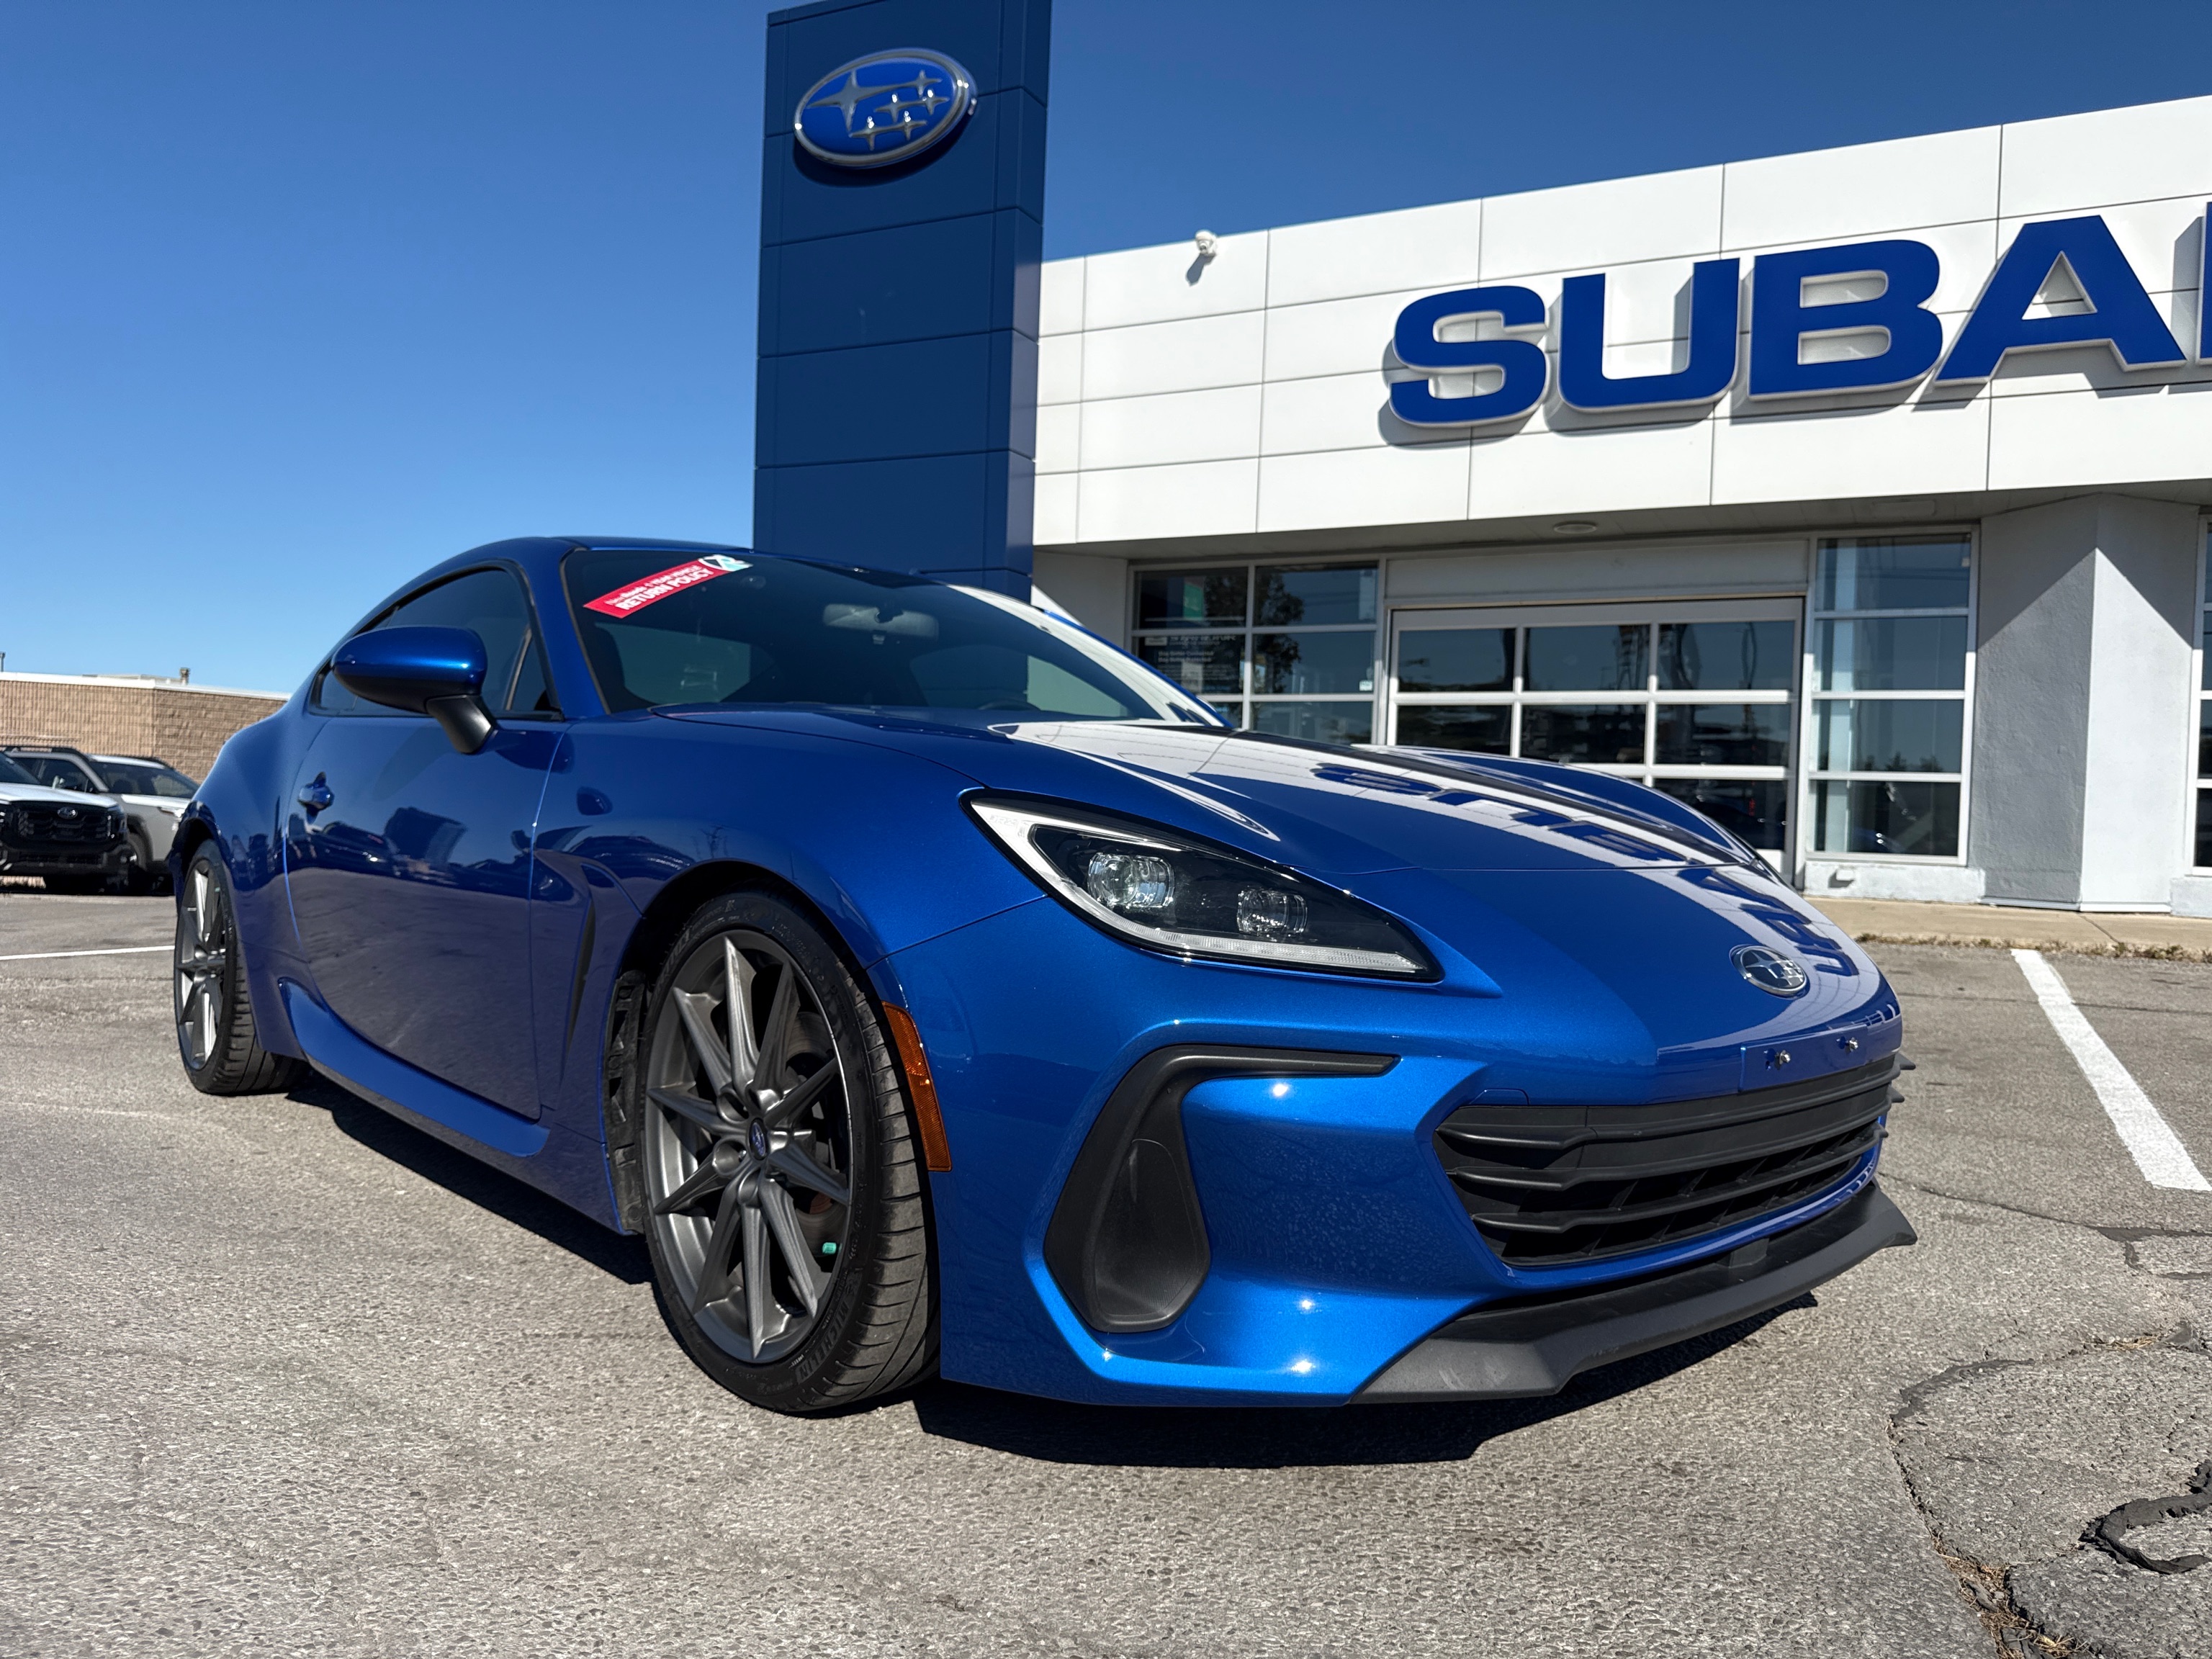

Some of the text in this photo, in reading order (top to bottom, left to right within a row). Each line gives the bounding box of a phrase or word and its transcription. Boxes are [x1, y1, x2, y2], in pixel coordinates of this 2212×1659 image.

[1390, 202, 2212, 425] SUBA
[616, 567, 715, 610] RETURN POLICY
[796, 1300, 850, 1383] MICHELIN
